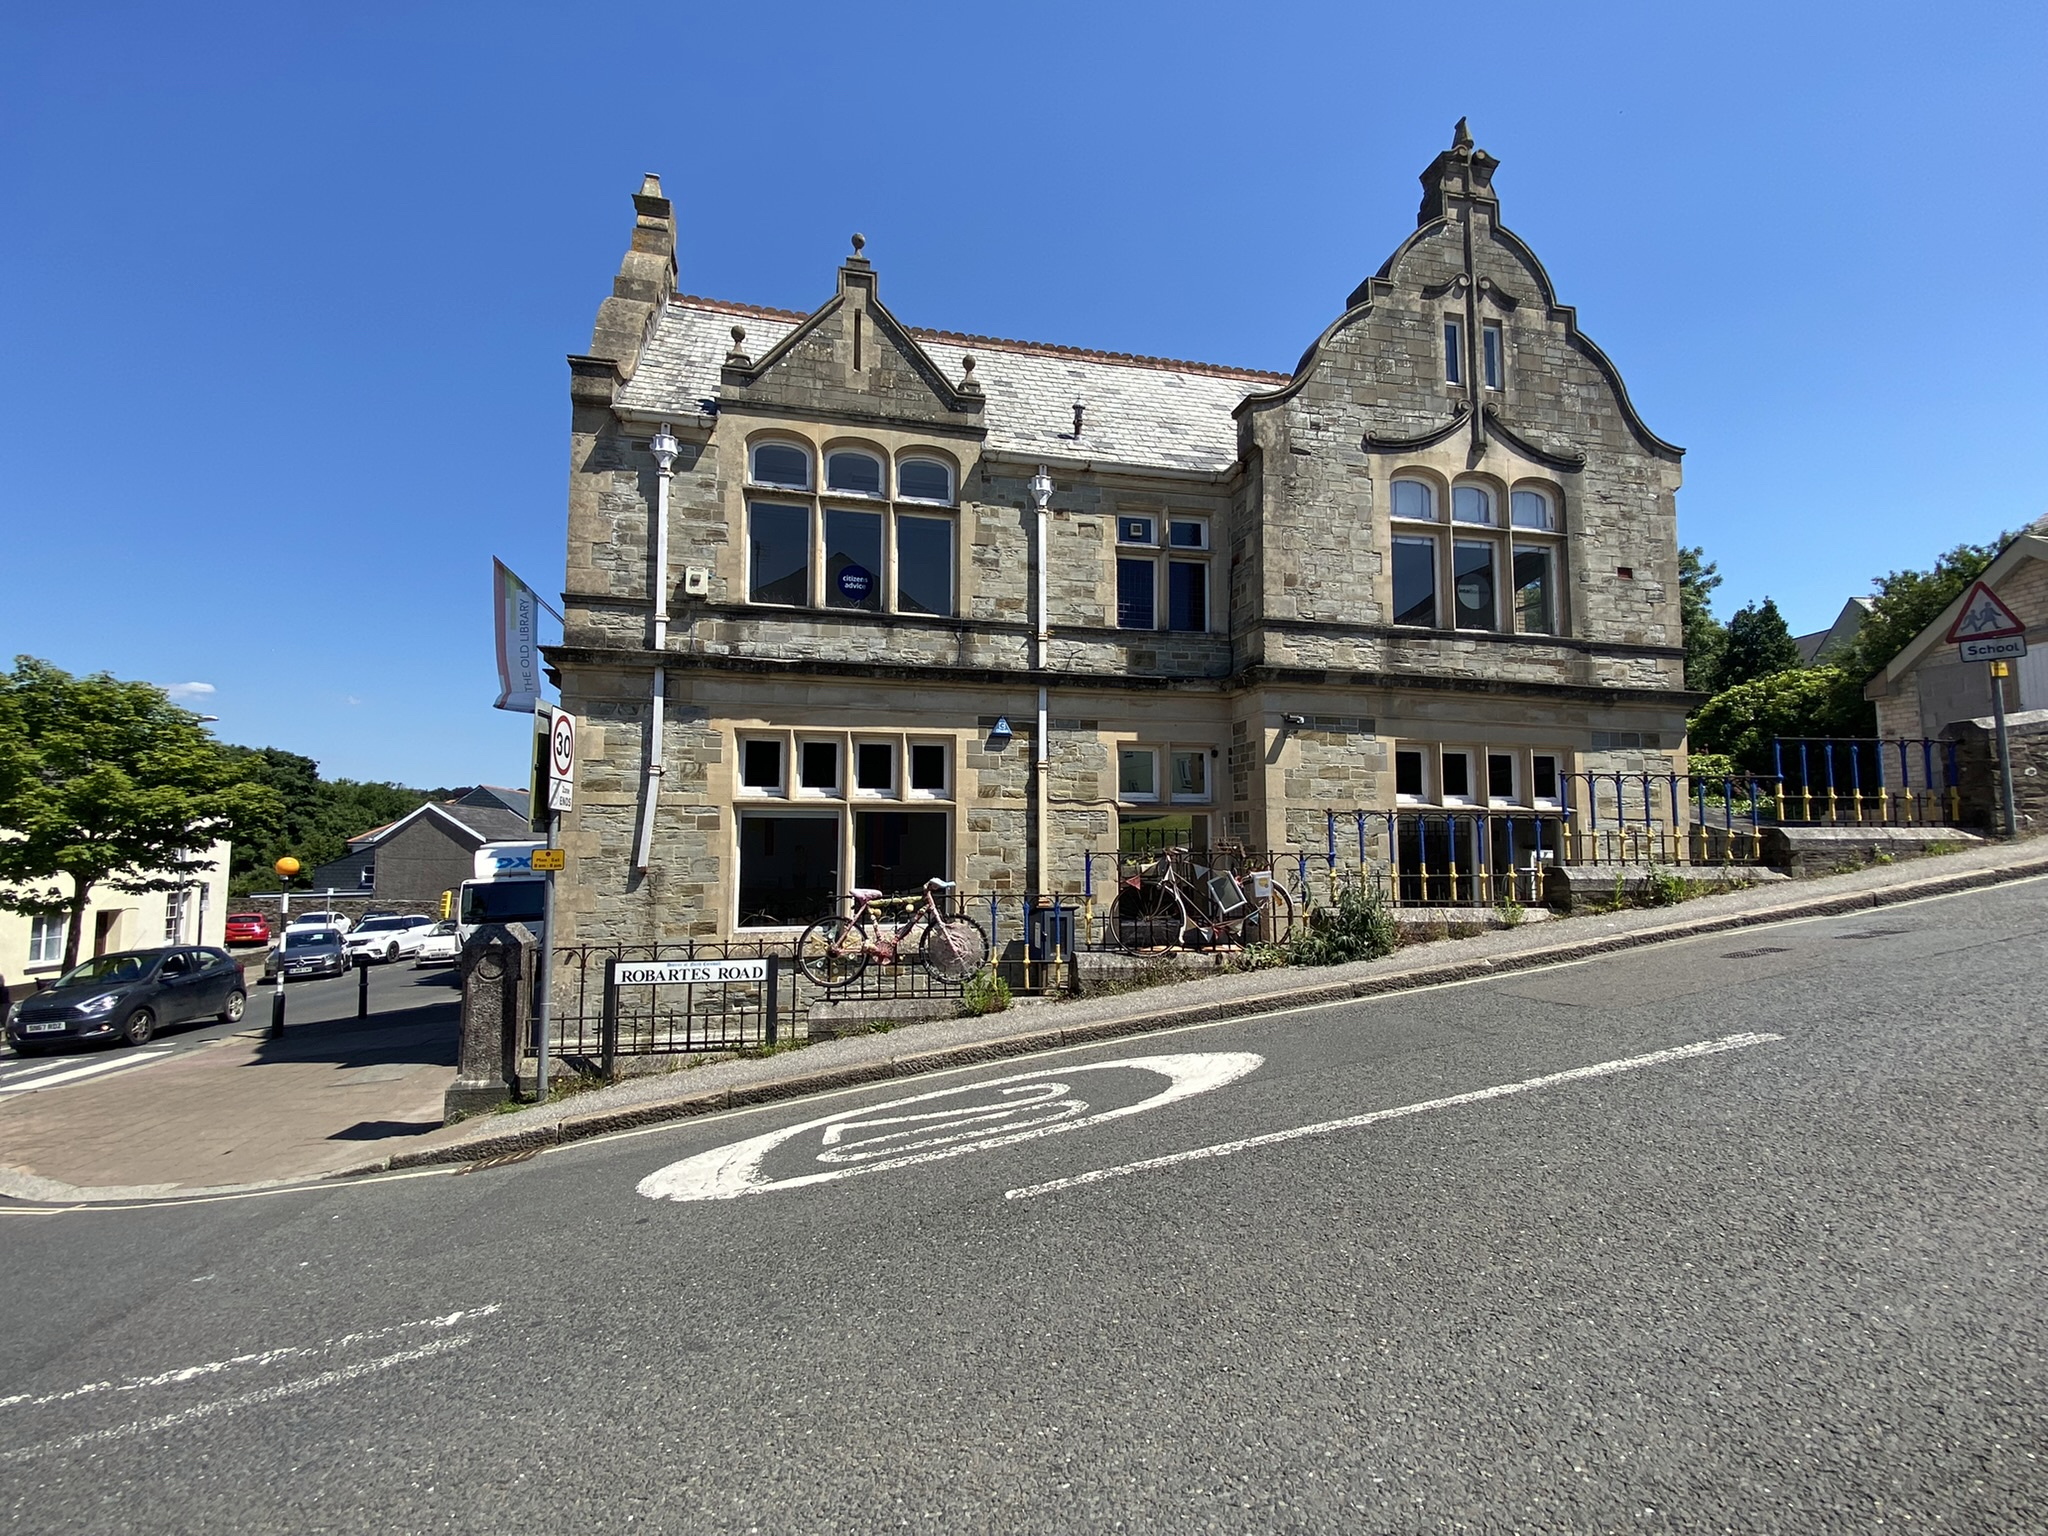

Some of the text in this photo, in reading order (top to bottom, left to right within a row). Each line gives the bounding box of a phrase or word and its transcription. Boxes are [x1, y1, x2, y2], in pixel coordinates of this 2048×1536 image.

[842, 575, 868, 583] citizens
[519, 598, 532, 692] THE OLD LIBRARY
[1967, 643, 2020, 656] School
[556, 732, 571, 759] 30
[559, 796, 571, 807] ENDS
[621, 966, 763, 983] ROBARTES ROAD
